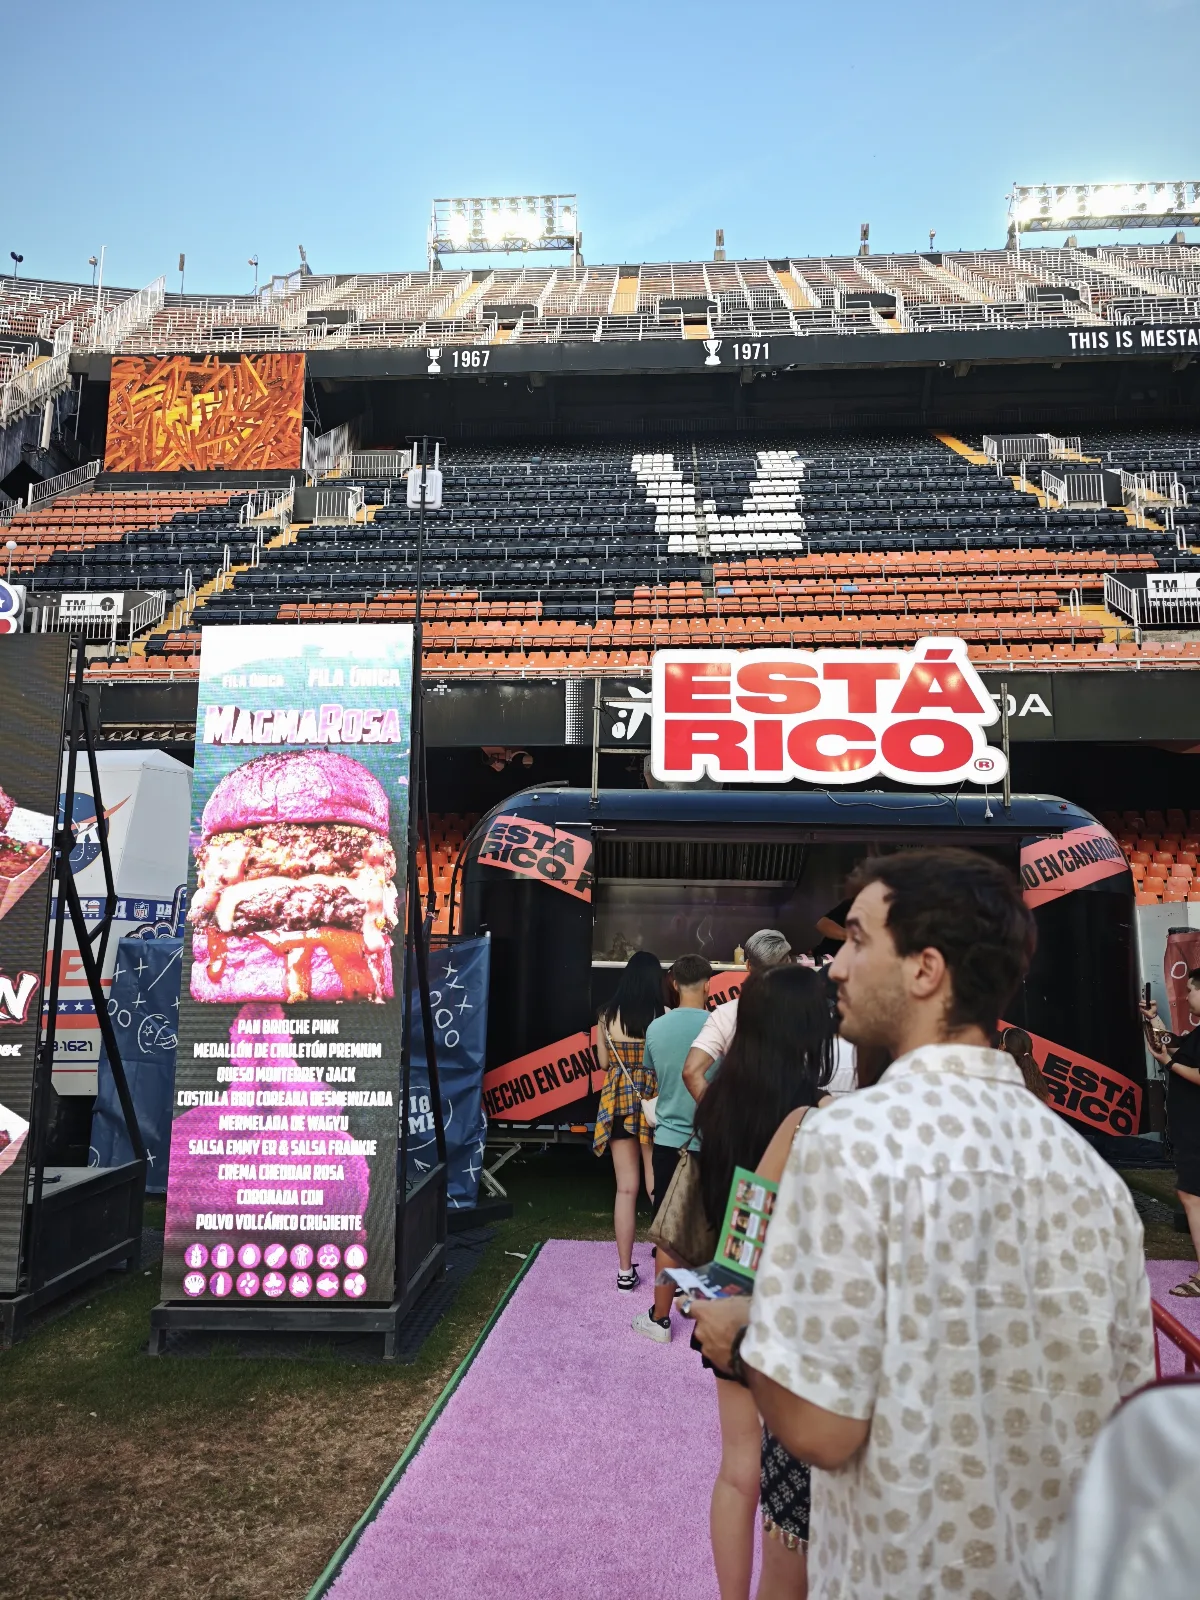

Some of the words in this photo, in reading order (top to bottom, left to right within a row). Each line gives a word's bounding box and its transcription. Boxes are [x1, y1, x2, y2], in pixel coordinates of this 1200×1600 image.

[1069, 331, 1109, 349] THIS
[1116, 331, 1133, 348] IS
[1141, 328, 1200, 347] MESTA
[452, 350, 490, 368] 1967
[732, 343, 769, 361] 1971
[1152, 580, 1178, 592] TM
[65, 600, 86, 611] TM
[222, 675, 246, 687] FILA
[308, 668, 344, 686] FILA
[350, 665, 400, 686] ÚNICA
[664, 649, 985, 714] ESTÁ
[488, 823, 575, 865] ESTÁ
[480, 840, 566, 880] RICO
[1034, 854, 1064, 883] EN
[1057, 837, 1122, 873] CANARIAS
[238, 1019, 261, 1034] PAN
[262, 1019, 311, 1034] BRIOCHE
[312, 1019, 339, 1034] PINK
[193, 1040, 253, 1058] MEDALLÓN
[254, 1043, 268, 1058] DE
[270, 1040, 327, 1058] CHULETÓN
[329, 1043, 382, 1058] PREMIUM
[217, 1067, 254, 1083] QUESO
[255, 1067, 325, 1083] MONTERREY
[326, 1067, 356, 1082] JACK
[482, 1073, 536, 1118] HECHO
[532, 1063, 561, 1095] EN
[1042, 1052, 1137, 1117] ESTÁ
[177, 1091, 229, 1106] COSTILLA
[231, 1091, 254, 1106] BBQ
[256, 1091, 309, 1106] COREANA
[310, 1091, 393, 1106] DESMENUZADA
[1043, 1076, 1133, 1135] RICO
[219, 1115, 289, 1131] MERMELADA
[291, 1115, 305, 1131] DE
[307, 1115, 349, 1131] WAGYU
[189, 1140, 225, 1155] SALSA
[226, 1140, 261, 1155] EMMY
[262, 1140, 277, 1155] ER
[279, 1140, 290, 1155] &
[290, 1140, 327, 1155] SALSA
[328, 1140, 377, 1155] FRANKIE
[218, 1164, 257, 1180] CREMA
[259, 1165, 311, 1180] CHEDDAR
[313, 1165, 345, 1180] ROSA
[237, 1189, 299, 1205] CORONADA
[300, 1190, 324, 1205] CON
[196, 1214, 233, 1230] POLVO
[235, 1211, 299, 1230] VOLCÁNICO
[300, 1214, 362, 1230] CRUJIENTE
